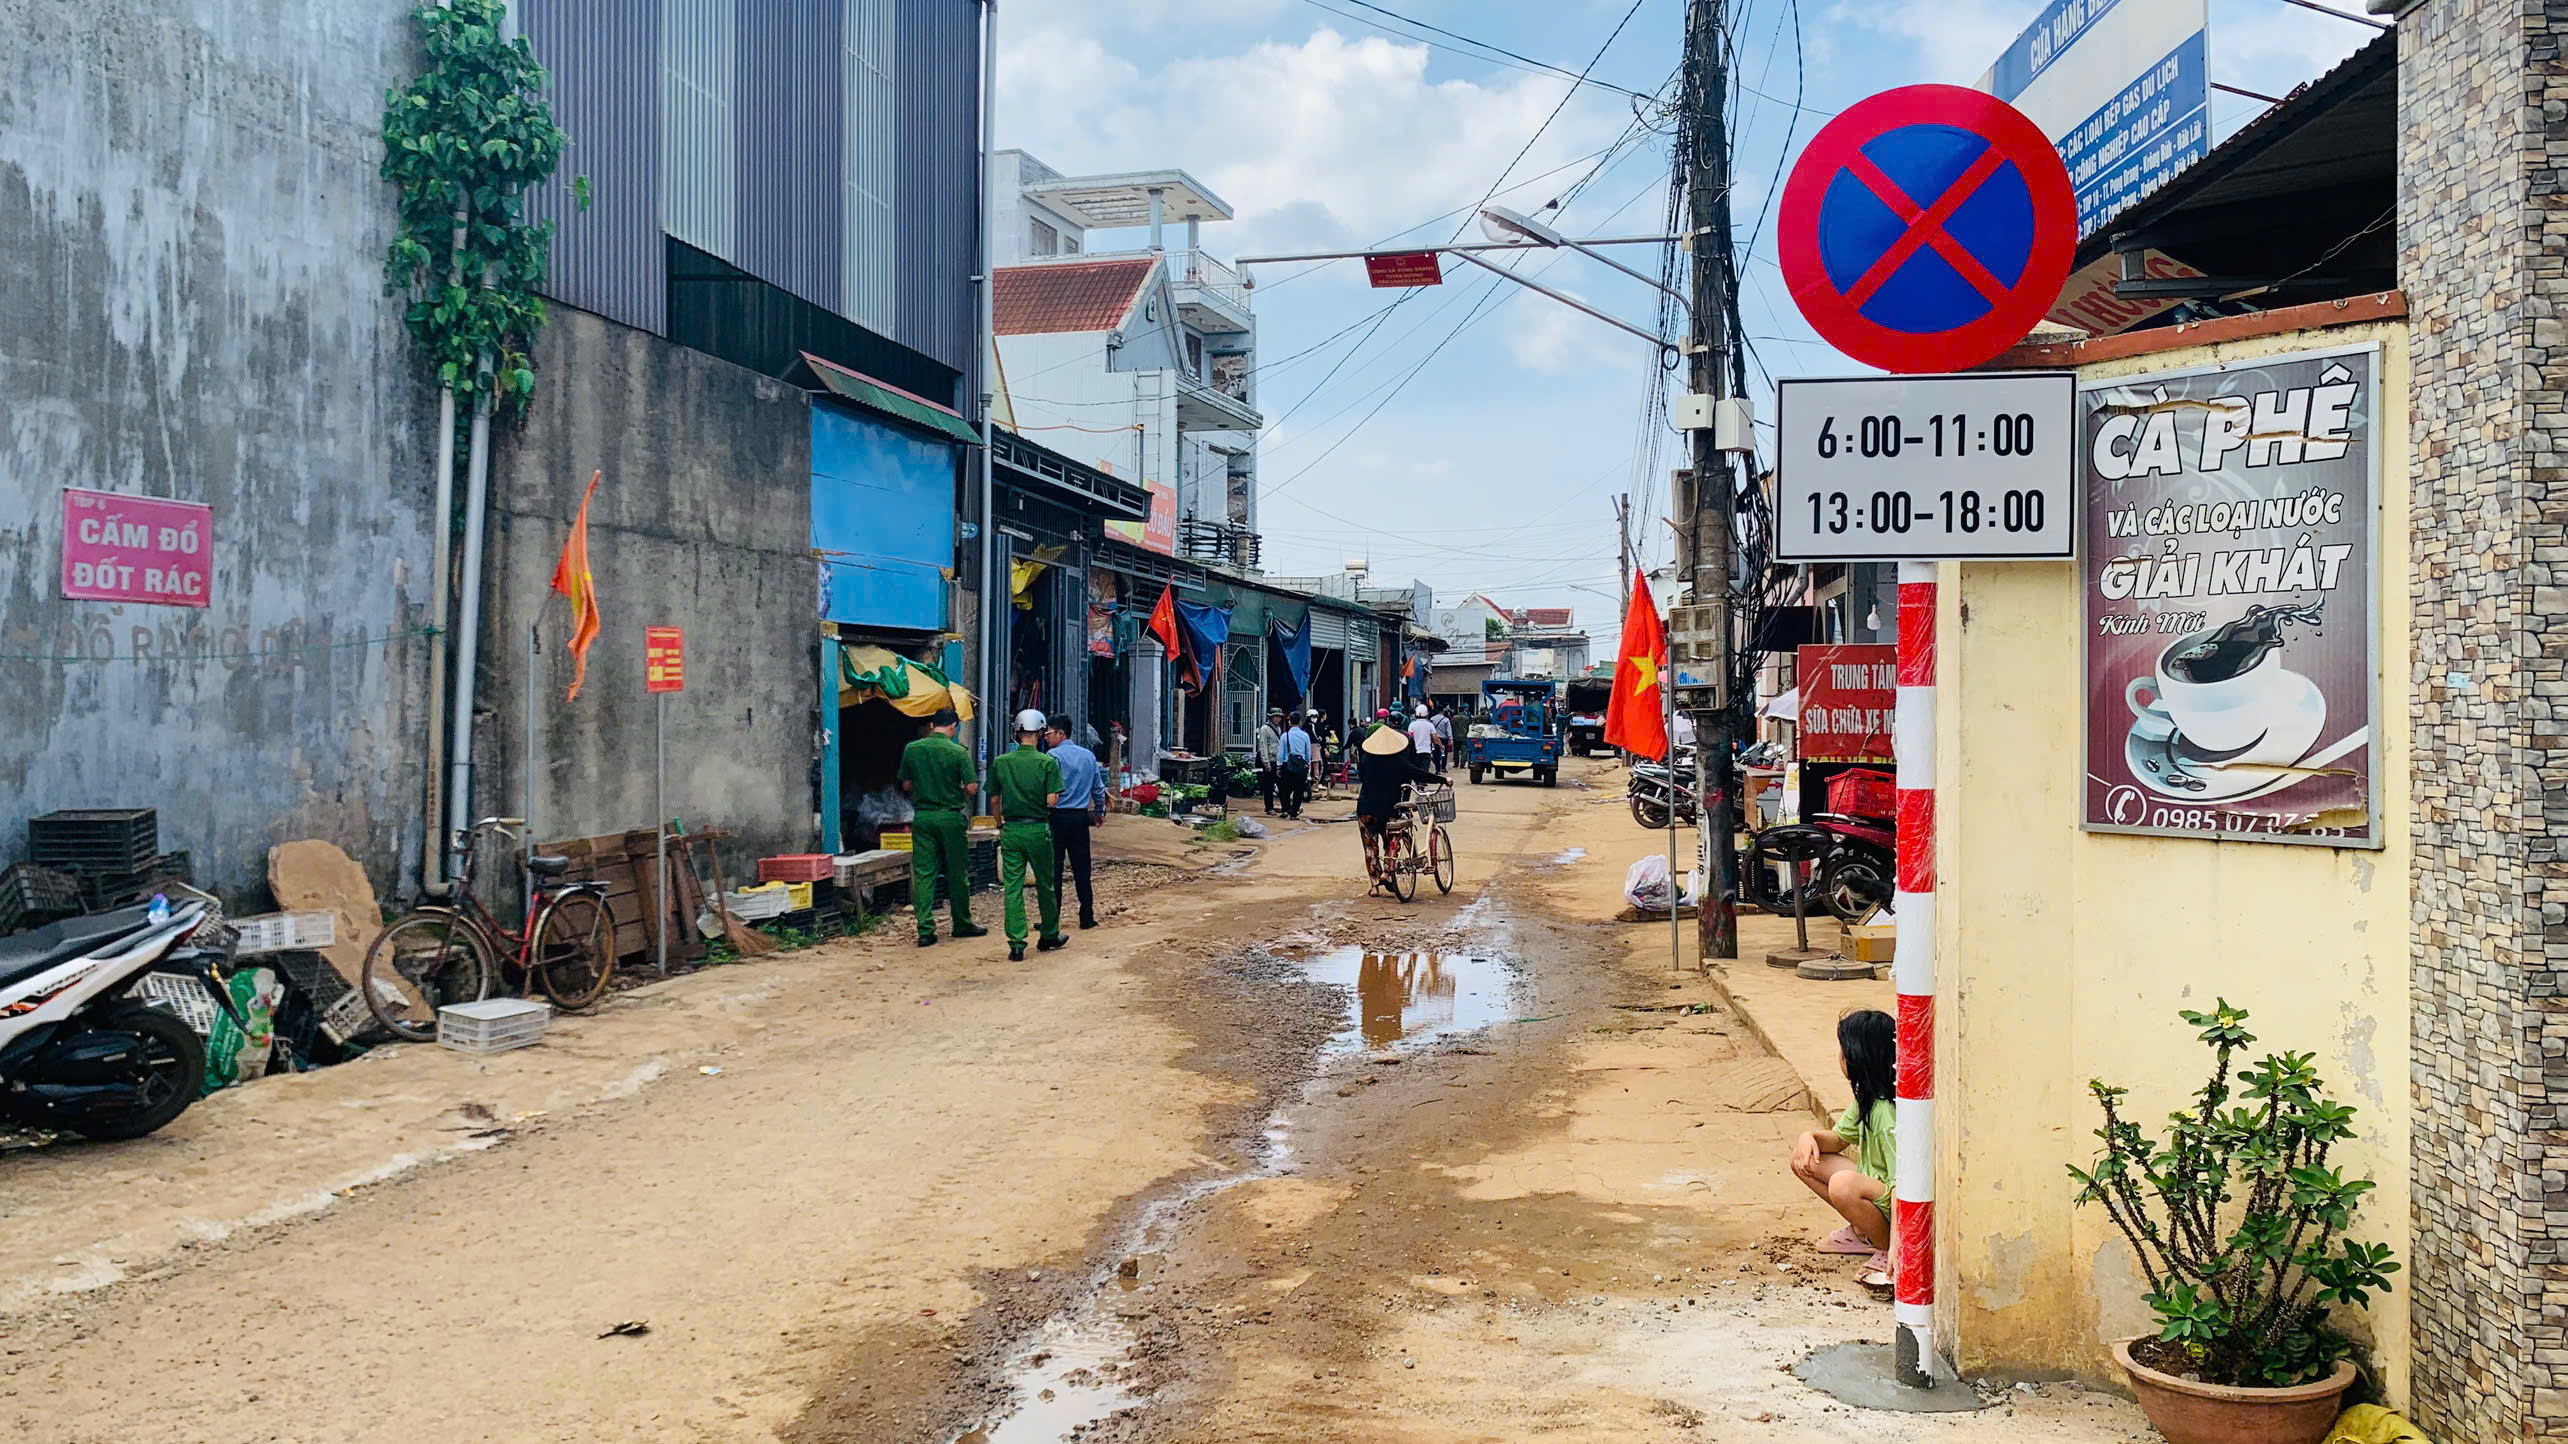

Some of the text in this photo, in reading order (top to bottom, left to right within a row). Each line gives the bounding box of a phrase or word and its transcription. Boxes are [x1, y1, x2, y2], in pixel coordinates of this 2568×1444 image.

[2030, 0, 2085, 73] CỬA HÀNG
[2067, 131, 2084, 159] CÁC
[2084, 120, 2103, 146] LOẠI
[2104, 97, 2120, 131] BẾP
[2122, 87, 2141, 117] GAS
[2142, 74, 2155, 102] DU
[2157, 54, 2179, 93] LỊCH
[2075, 153, 2097, 186] CÔNG
[2098, 129, 2129, 169] NGHIỆP
[2131, 115, 2150, 146] CAO
[2151, 95, 2170, 131] CẤP
[1818, 413, 2034, 459] 6:00-11:00
[2200, 362, 2360, 472] PHÊ
[80, 513, 199, 554] CẤM ĐỔ
[1807, 489, 2044, 535] 13:00-18:00
[2107, 486, 2344, 539] VÀ CÁC LOẠI NƯỚC
[72, 556, 202, 596] ĐỐT RÁC
[2099, 532, 2353, 600] GIẢI KHÁT
[2097, 611, 2207, 636] Kính Mời
[1831, 659, 1896, 690] TRUNG TÂM
[1831, 704, 1862, 735] CHỮA
[1866, 709, 1882, 735] XE
[2152, 807, 2218, 832] 0985
